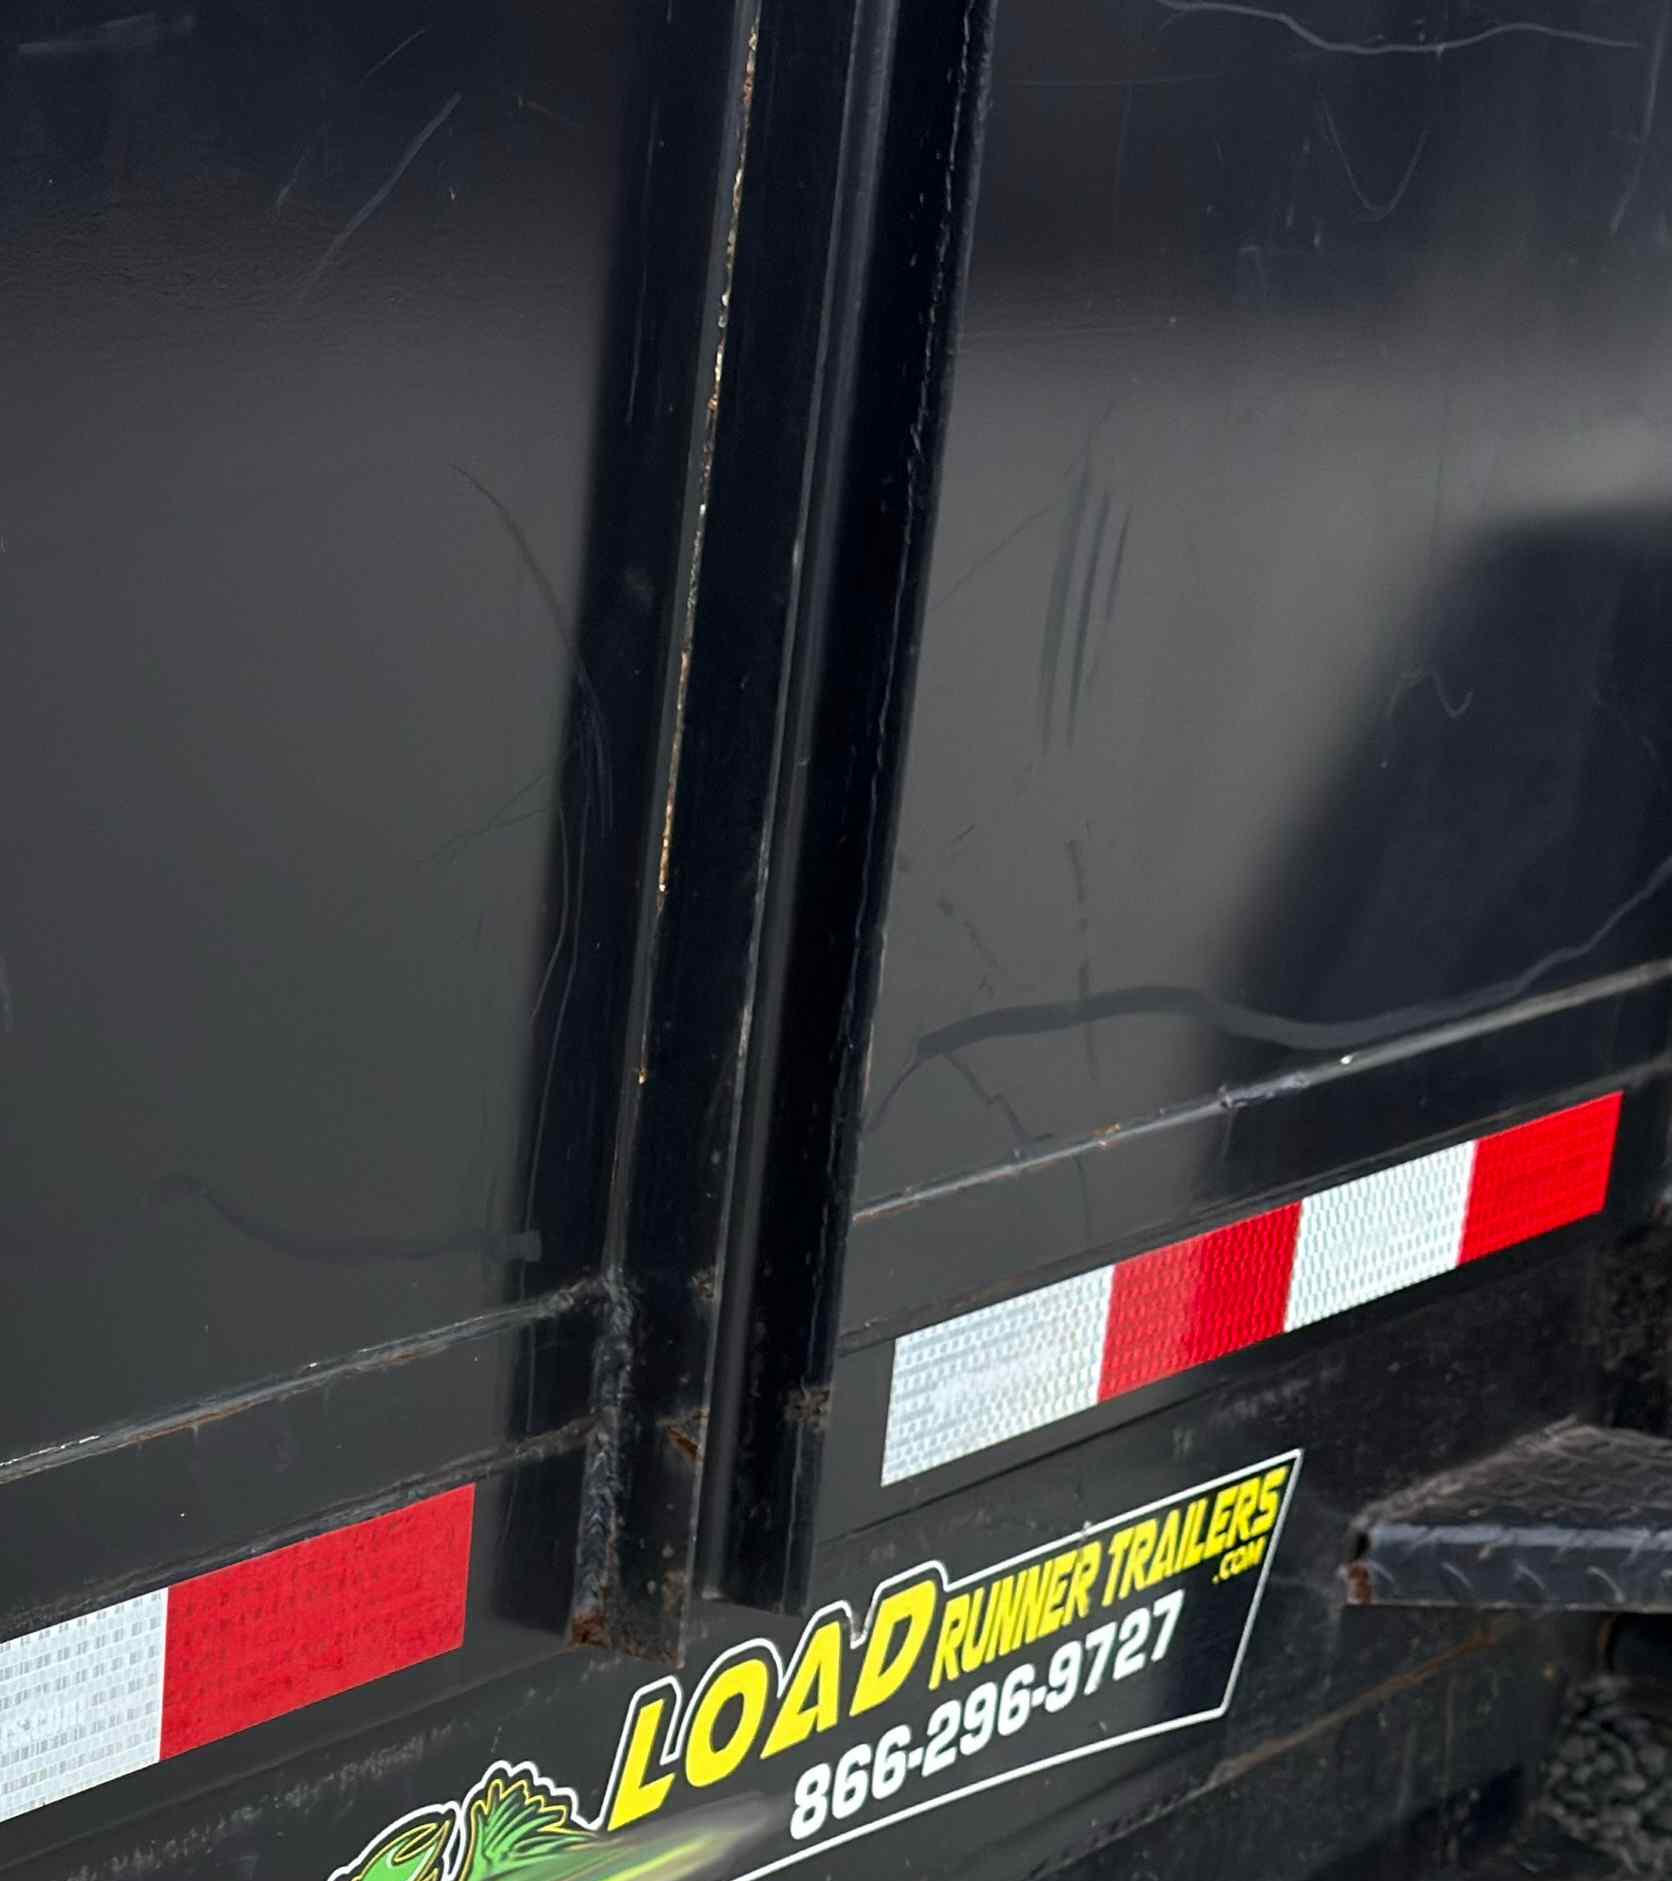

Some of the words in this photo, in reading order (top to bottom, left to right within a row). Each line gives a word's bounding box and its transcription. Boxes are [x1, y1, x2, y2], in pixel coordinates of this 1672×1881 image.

[610, 1579, 938, 1832] LOAD
[930, 1540, 1102, 1691] RUNNER
[1104, 1466, 1288, 1607] TRAILERS
[1212, 1535, 1268, 1585] .COM
[789, 1588, 1185, 1841] 866-296-9727
